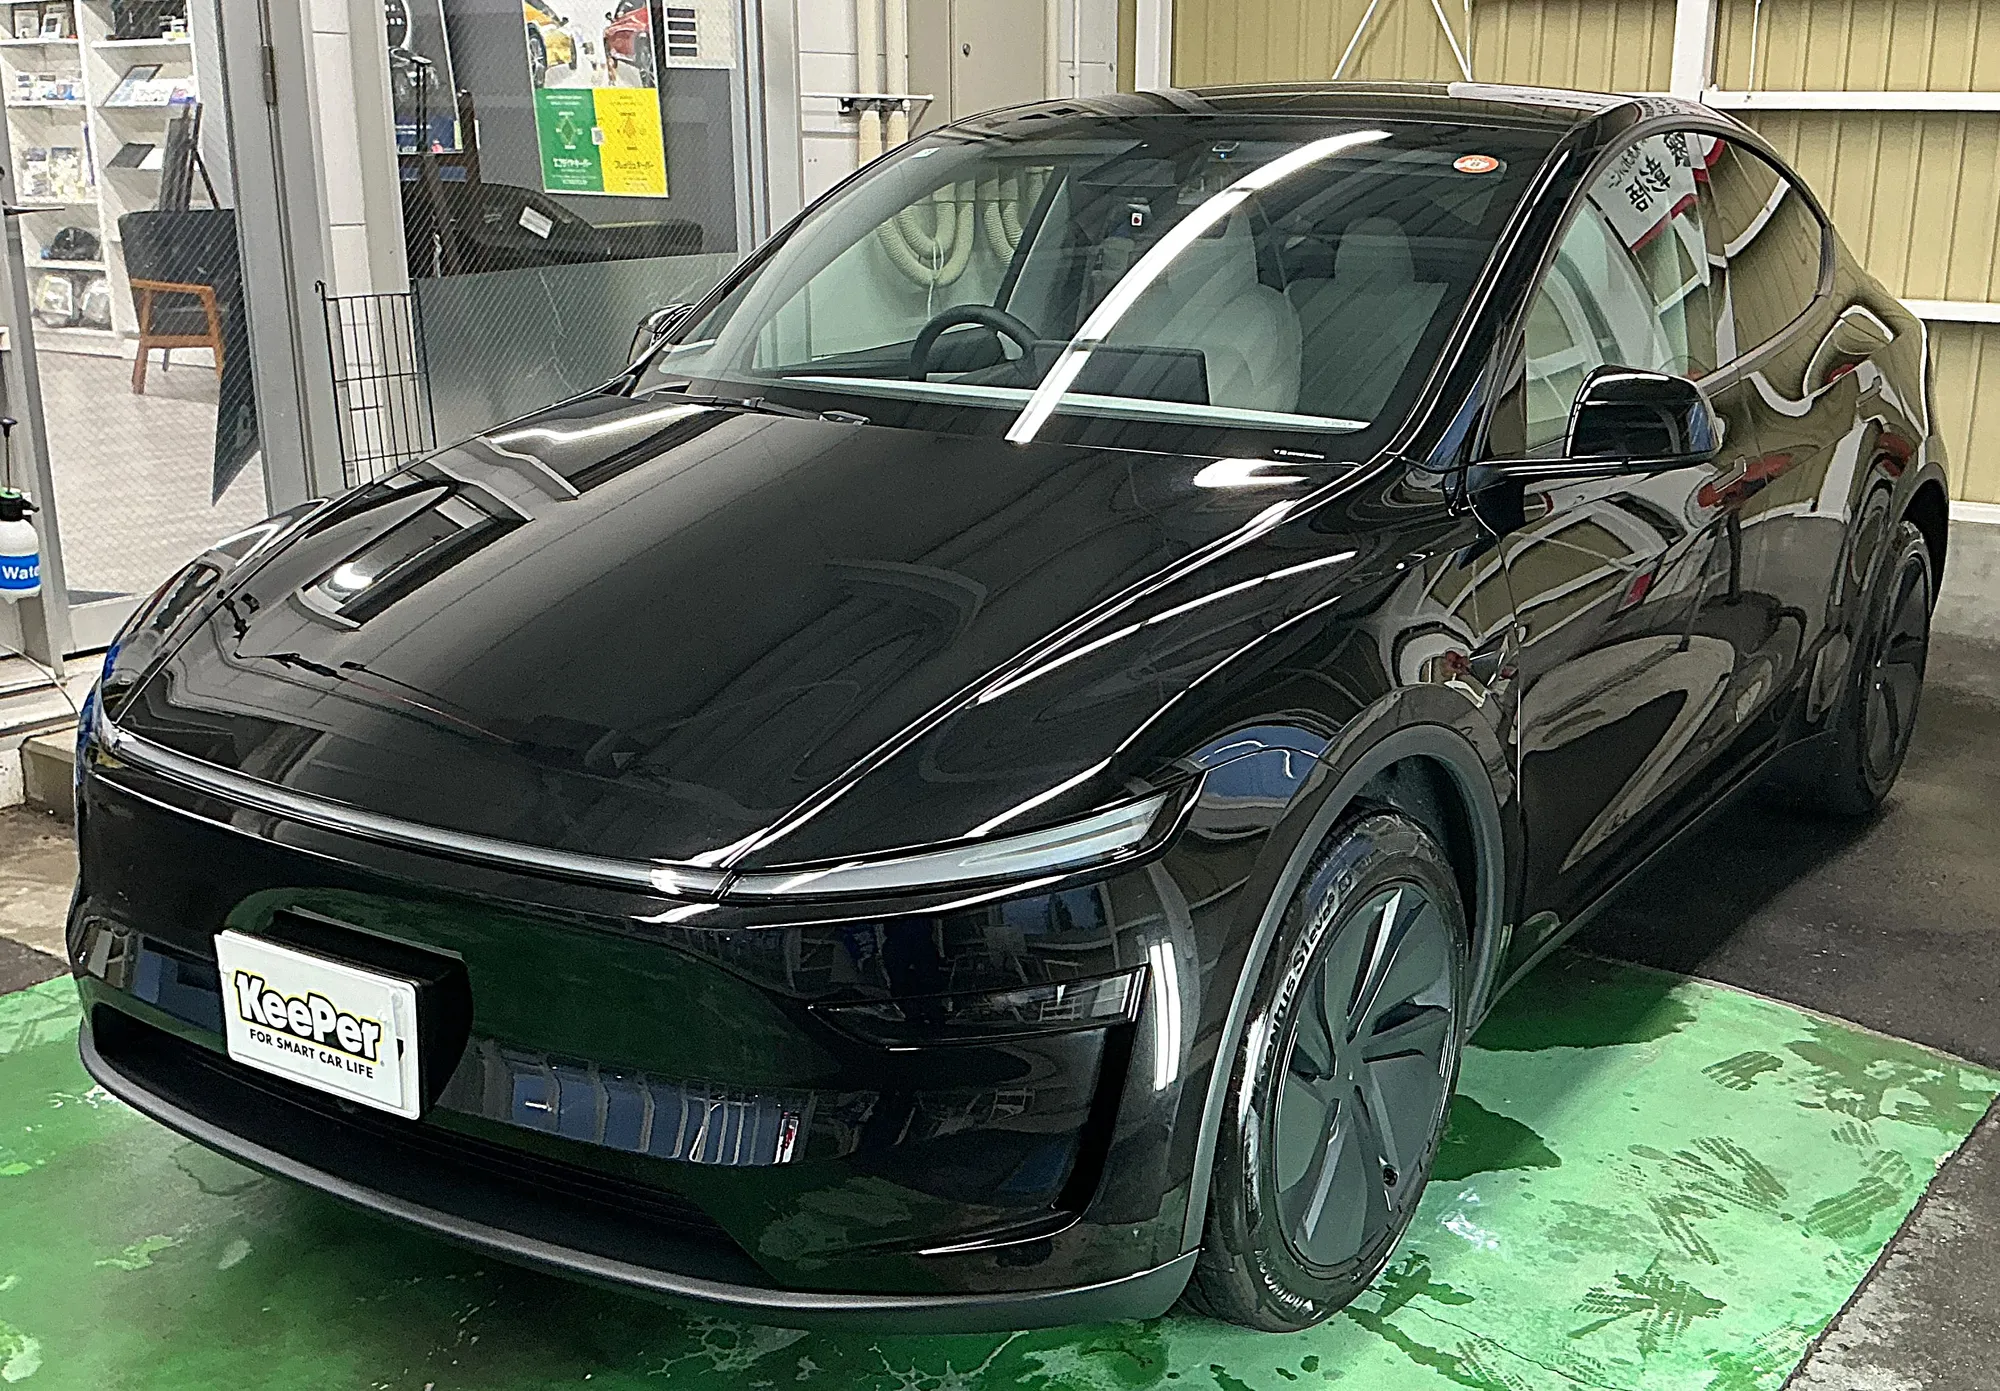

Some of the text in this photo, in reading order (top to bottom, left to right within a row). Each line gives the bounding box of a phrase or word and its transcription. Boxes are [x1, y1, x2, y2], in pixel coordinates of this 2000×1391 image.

[233, 969, 383, 1064] KeePer
[250, 1028, 374, 1079] FOR SMART CAR LIFE
